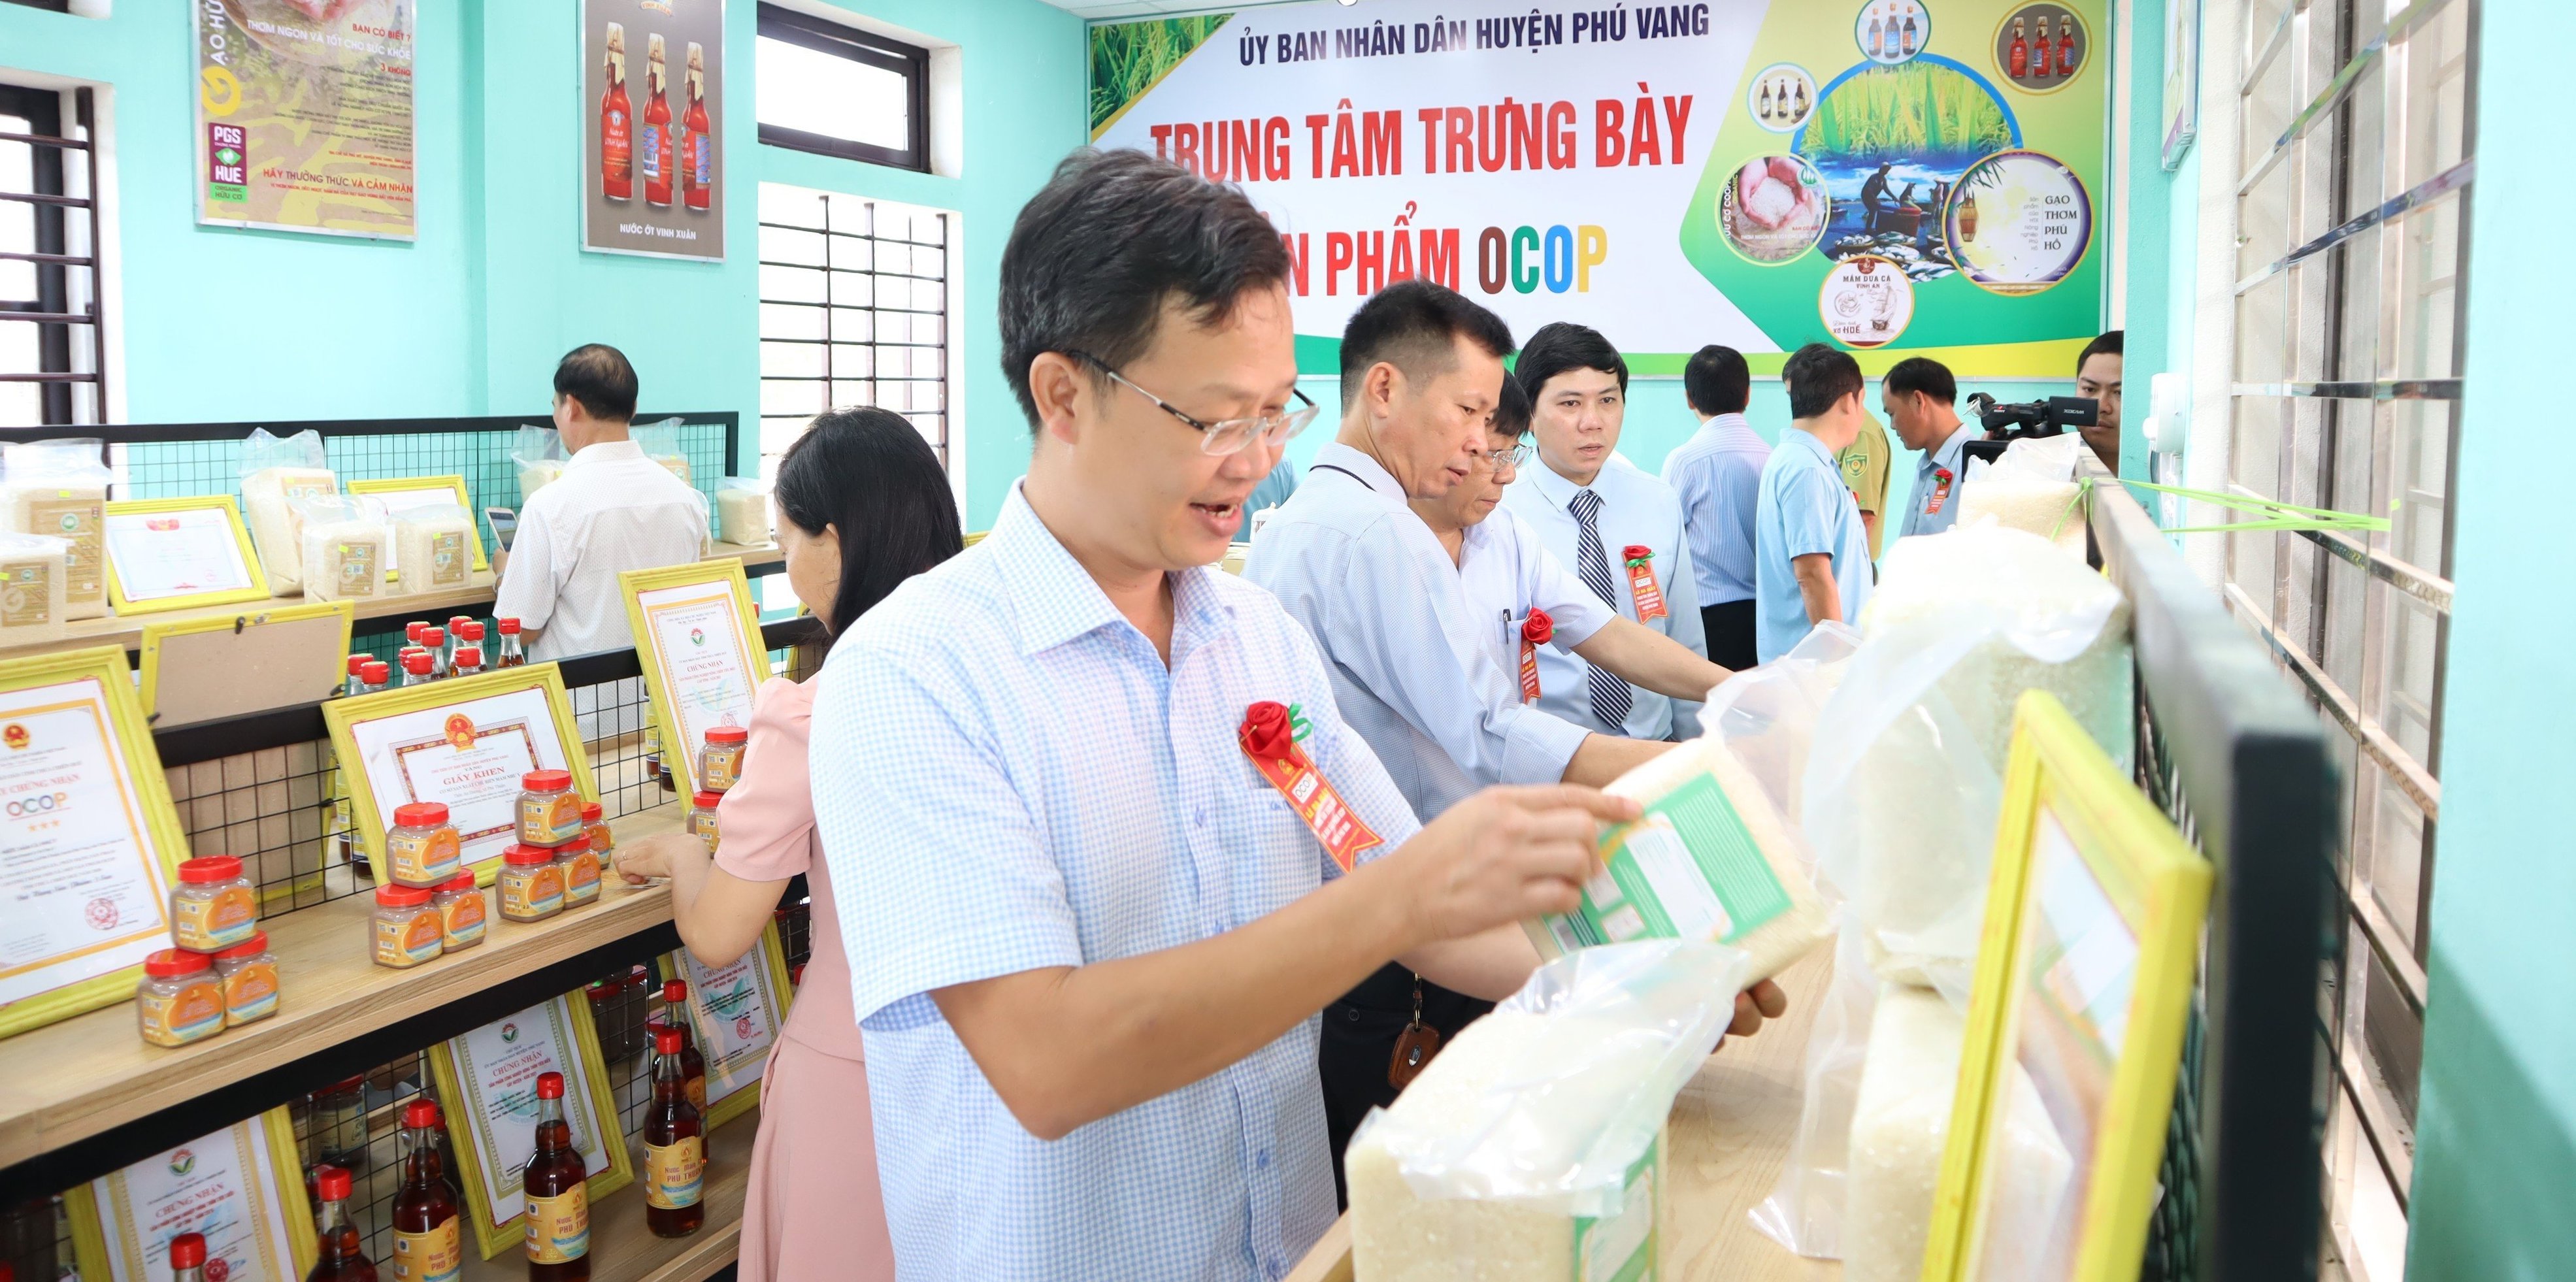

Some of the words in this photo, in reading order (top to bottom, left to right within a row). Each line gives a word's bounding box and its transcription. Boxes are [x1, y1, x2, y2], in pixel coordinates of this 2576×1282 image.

[246, 19, 275, 33] THƠM
[277, 25, 308, 39] NGON
[344, 39, 364, 50] CHO
[352, 23, 371, 34] BẠN
[372, 27, 386, 37] CÓ
[388, 29, 405, 41] BIẾT
[1240, 26, 1269, 66] ỦY
[1278, 29, 1327, 63] BAN
[1336, 19, 1406, 59] NHÂN
[1414, 14, 1466, 54] DÂN
[1476, 8, 1562, 54] HUYỆN
[1572, 2, 1626, 44] PHÚ
[1636, 3, 1709, 39] VANG
[380, 63, 386, 72] 3
[214, 125, 242, 144] PGS
[1150, 116, 1290, 184] TRUNG
[1306, 98, 1402, 178] TÂM
[1418, 97, 1576, 174] TRƯNG
[1595, 82, 1694, 168] BÀY
[215, 165, 242, 183] HUE
[2045, 195, 2070, 206] GẠO
[2045, 210, 2077, 220] THƠM
[620, 223, 643, 234] NƯỚC
[644, 224, 654, 235] ỚT
[655, 227, 674, 237] VINH
[676, 229, 696, 240] XUÂN
[2045, 224, 2068, 235] PHÚ
[1326, 200, 1460, 296] PHẨM
[1478, 224, 1608, 295] OCOP
[474, 766, 505, 780] KHEN
[7, 792, 68, 816] OCOP
[492, 1060, 521, 1077] CHỨNG
[521, 1051, 542, 1066] NHẬN
